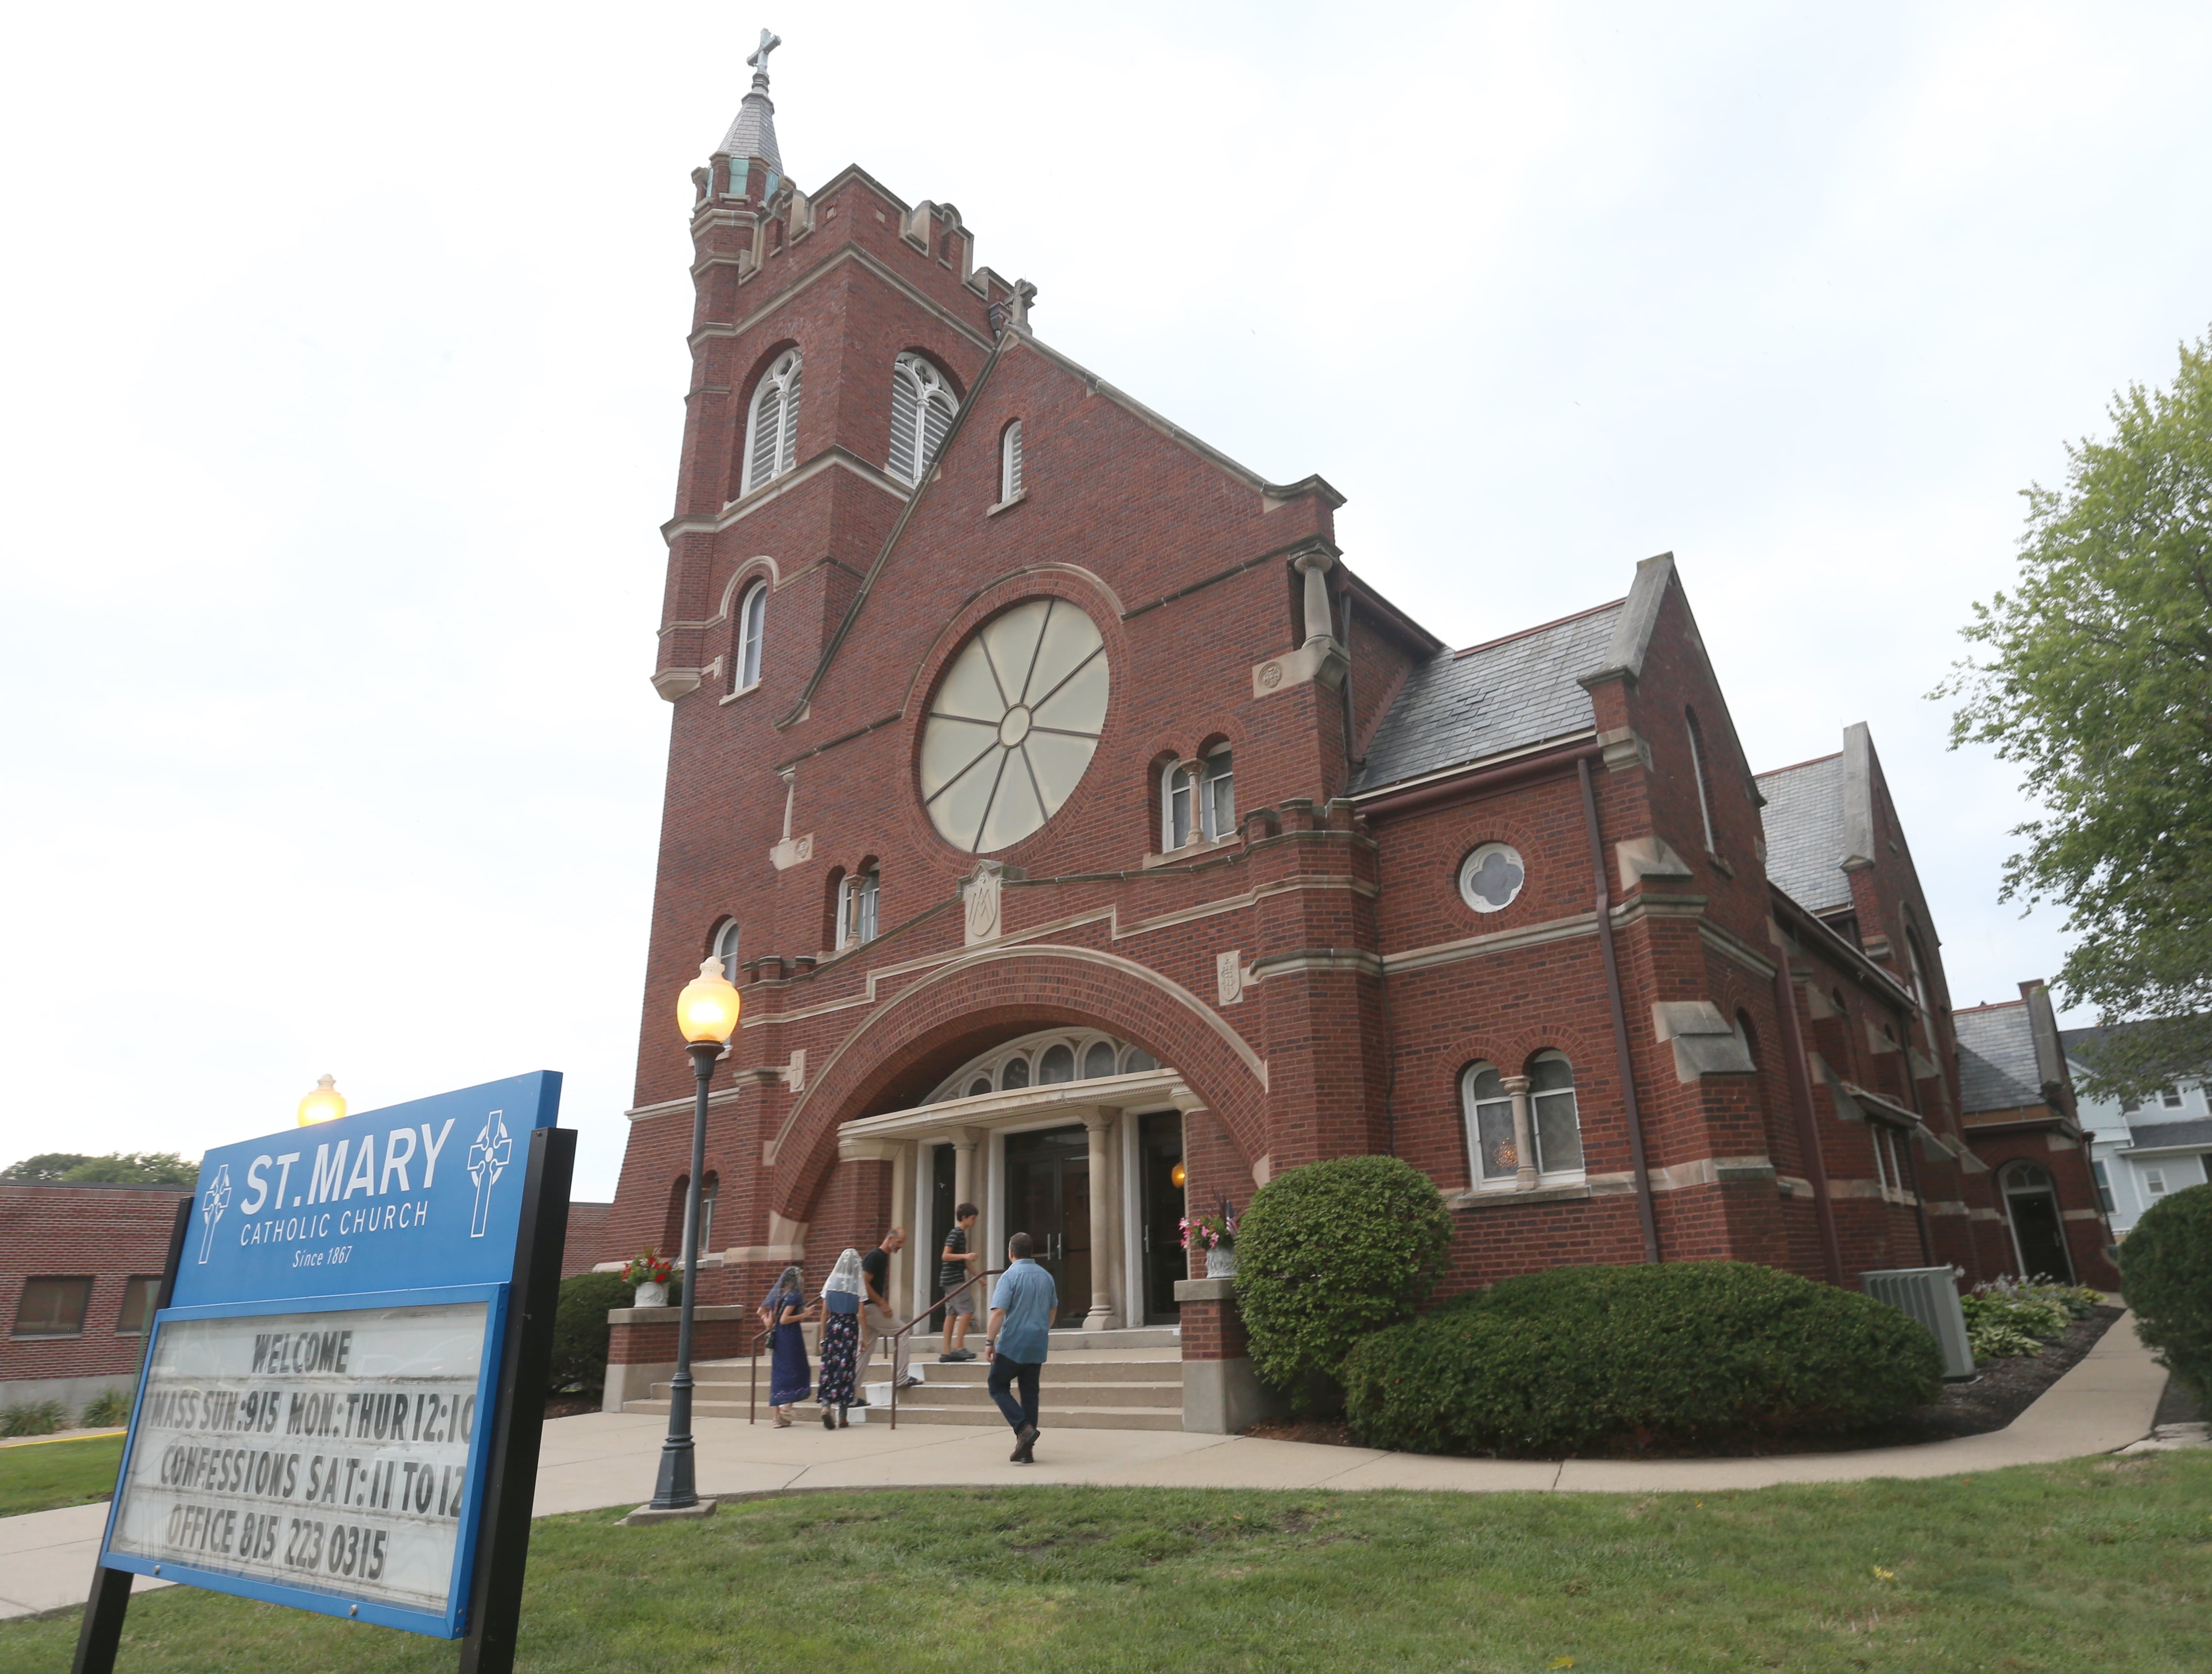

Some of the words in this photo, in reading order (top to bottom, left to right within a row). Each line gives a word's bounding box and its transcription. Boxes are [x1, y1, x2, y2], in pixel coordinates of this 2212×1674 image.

[240, 1213, 330, 1246] CATHOLIC
[340, 1200, 429, 1236] CHURCH
[293, 1250, 324, 1268] Since
[327, 1245, 353, 1264] 1867
[251, 1330, 353, 1374] WELCOME
[150, 1390, 201, 1429] MASS
[161, 1445, 299, 1498] CONFESSIONS
[168, 1503, 237, 1553] OFFICE
[239, 1512, 280, 1561] 815
[284, 1518, 324, 1570] 223
[328, 1524, 387, 1581] 0315
